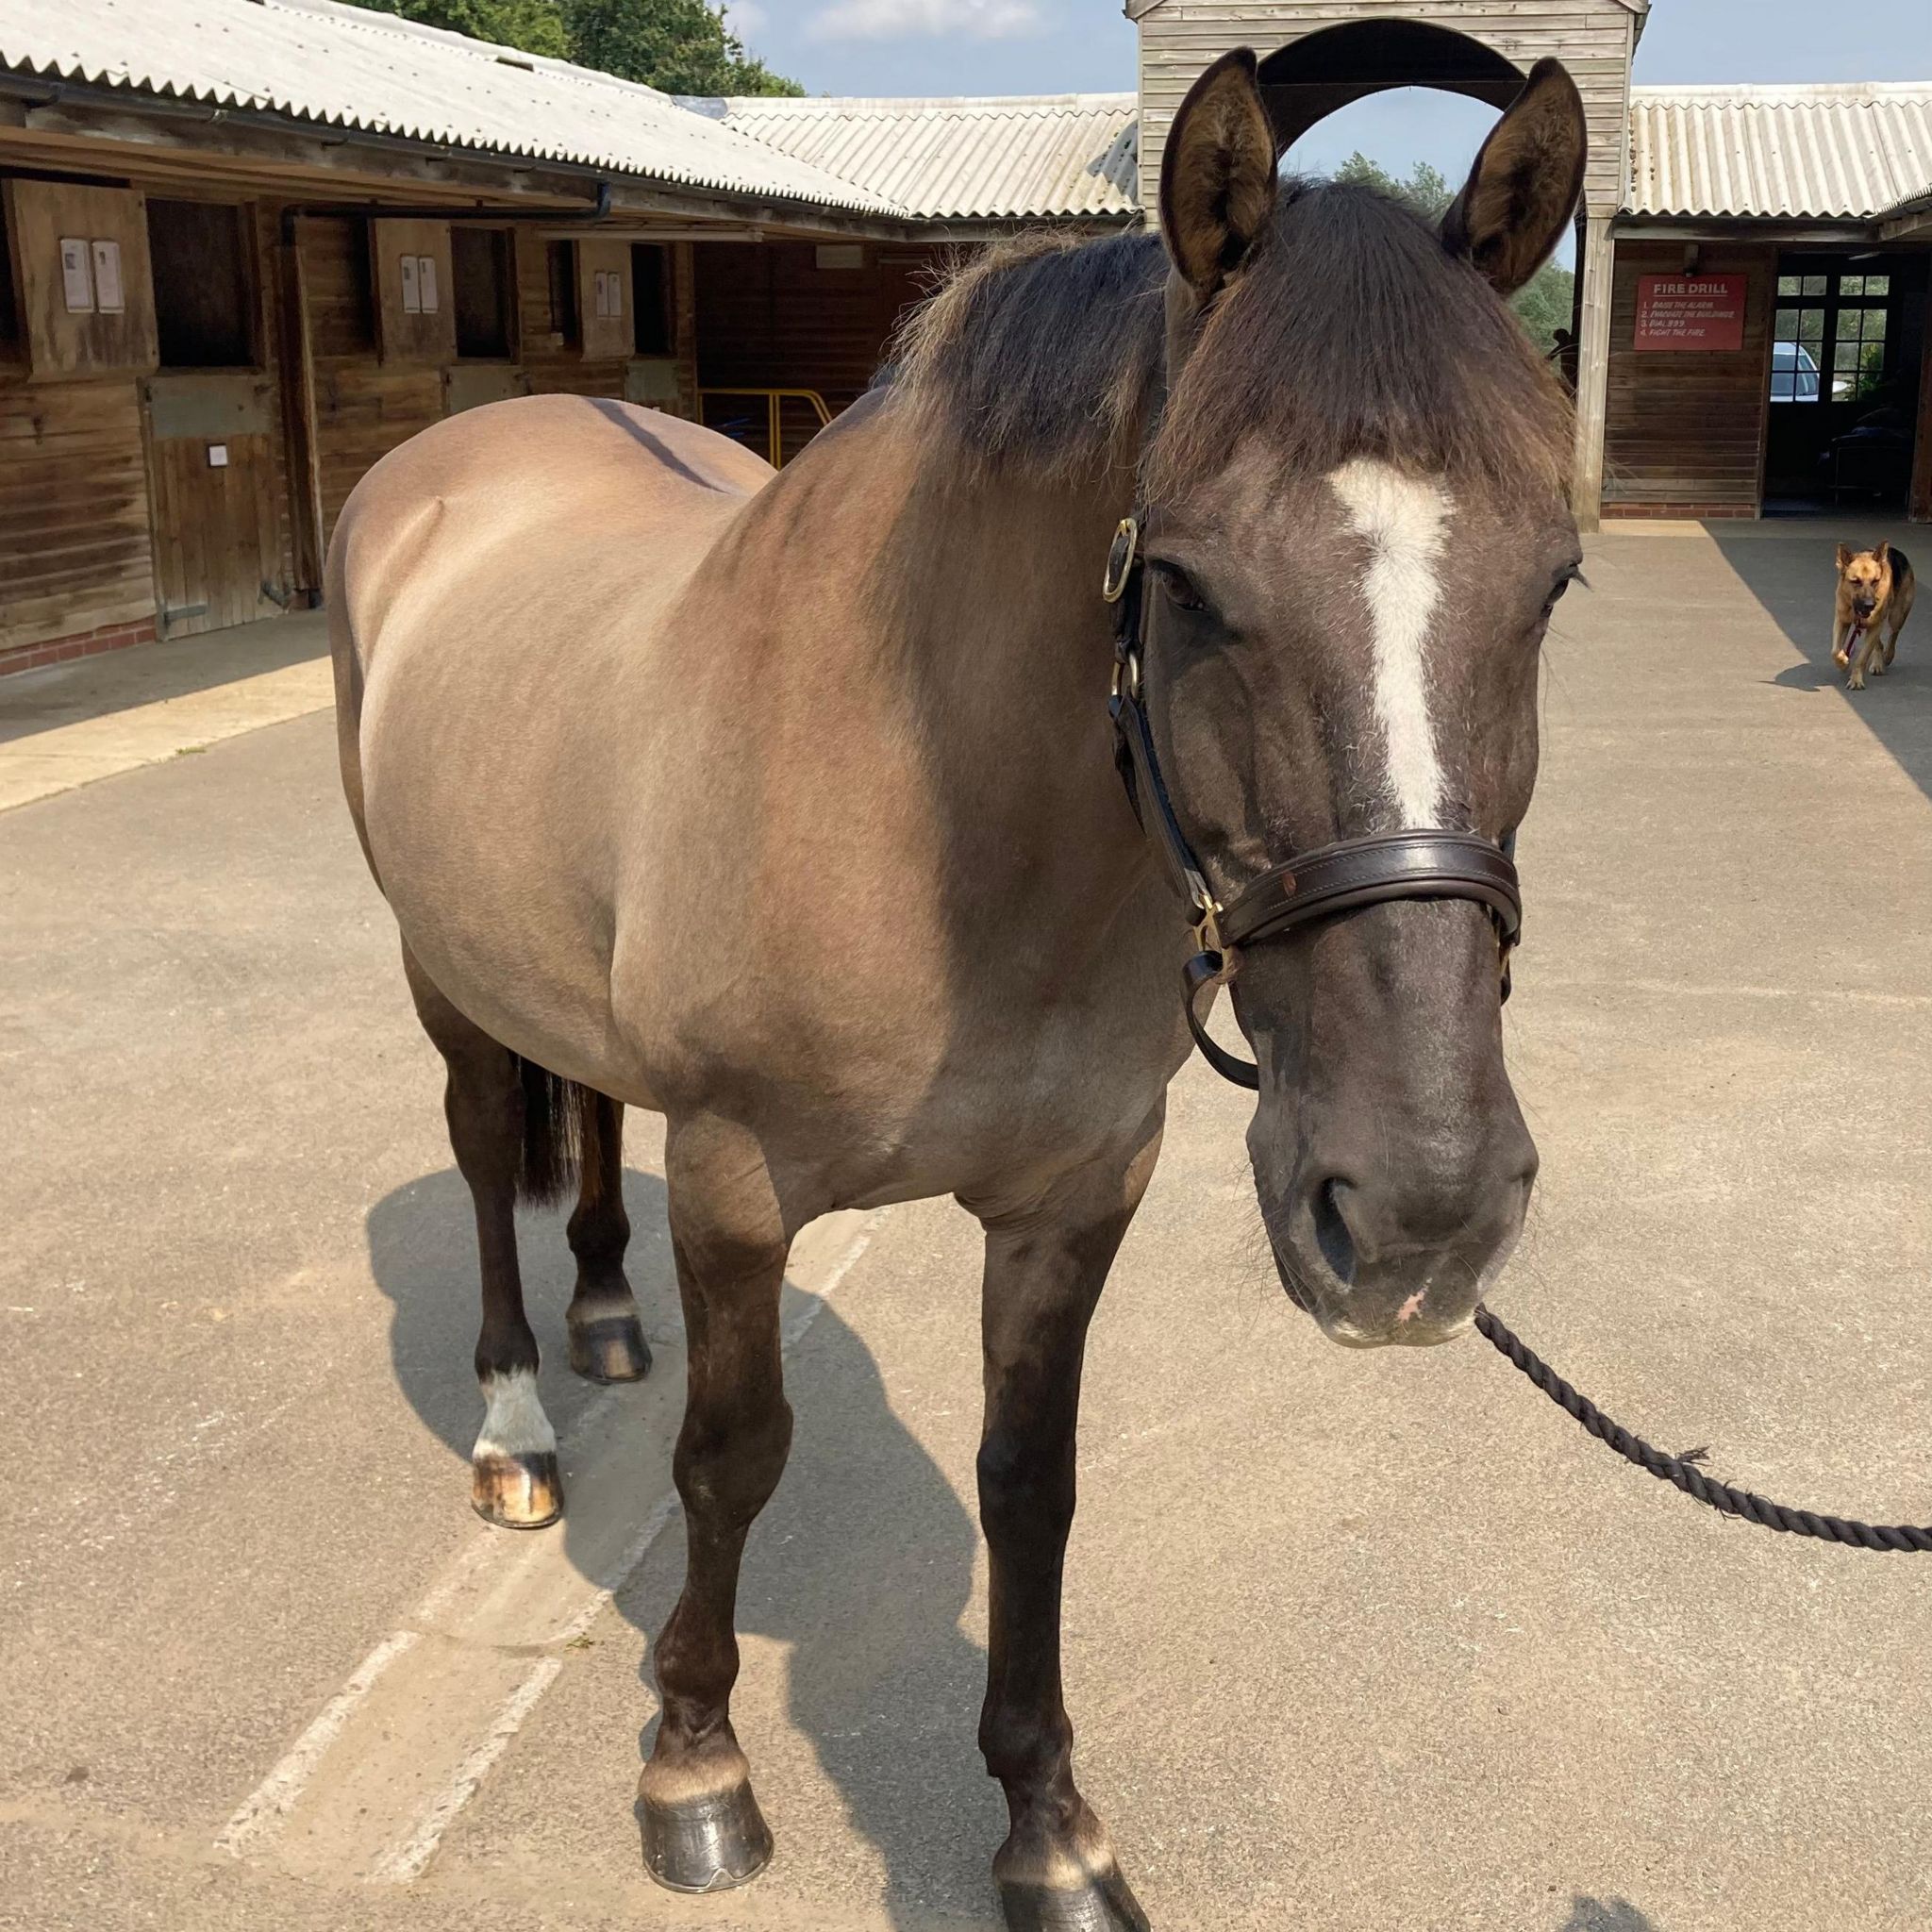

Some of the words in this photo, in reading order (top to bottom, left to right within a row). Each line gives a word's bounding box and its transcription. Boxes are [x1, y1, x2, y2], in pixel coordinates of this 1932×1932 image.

[1654, 284, 1686, 293] FIRE
[1688, 284, 1727, 293] DRILL
[1649, 319, 1666, 327] DIAL
[1649, 328, 1671, 337] FIGHT
[1673, 328, 1687, 337] THE
